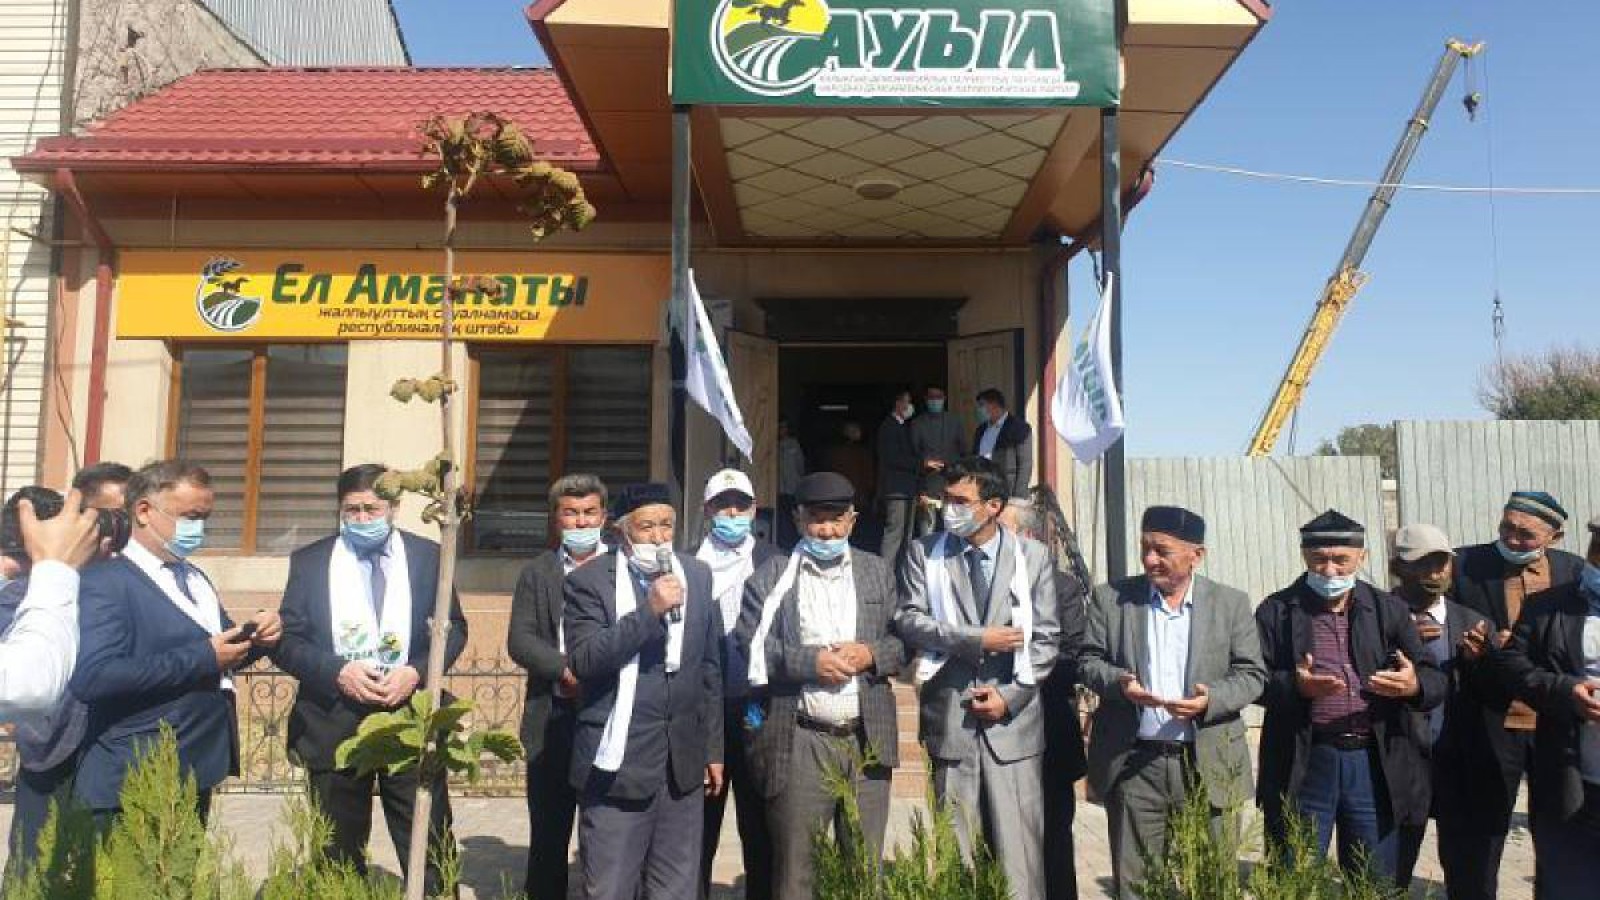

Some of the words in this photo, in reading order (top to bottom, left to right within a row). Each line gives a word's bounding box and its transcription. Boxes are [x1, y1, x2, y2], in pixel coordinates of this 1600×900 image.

[822, 9, 1063, 71] АУЫЛ
[271, 263, 332, 304] Ел
[337, 320, 461, 336] республикалқ
[466, 321, 518, 335] штабы
[434, 308, 539, 320] суалнамасы
